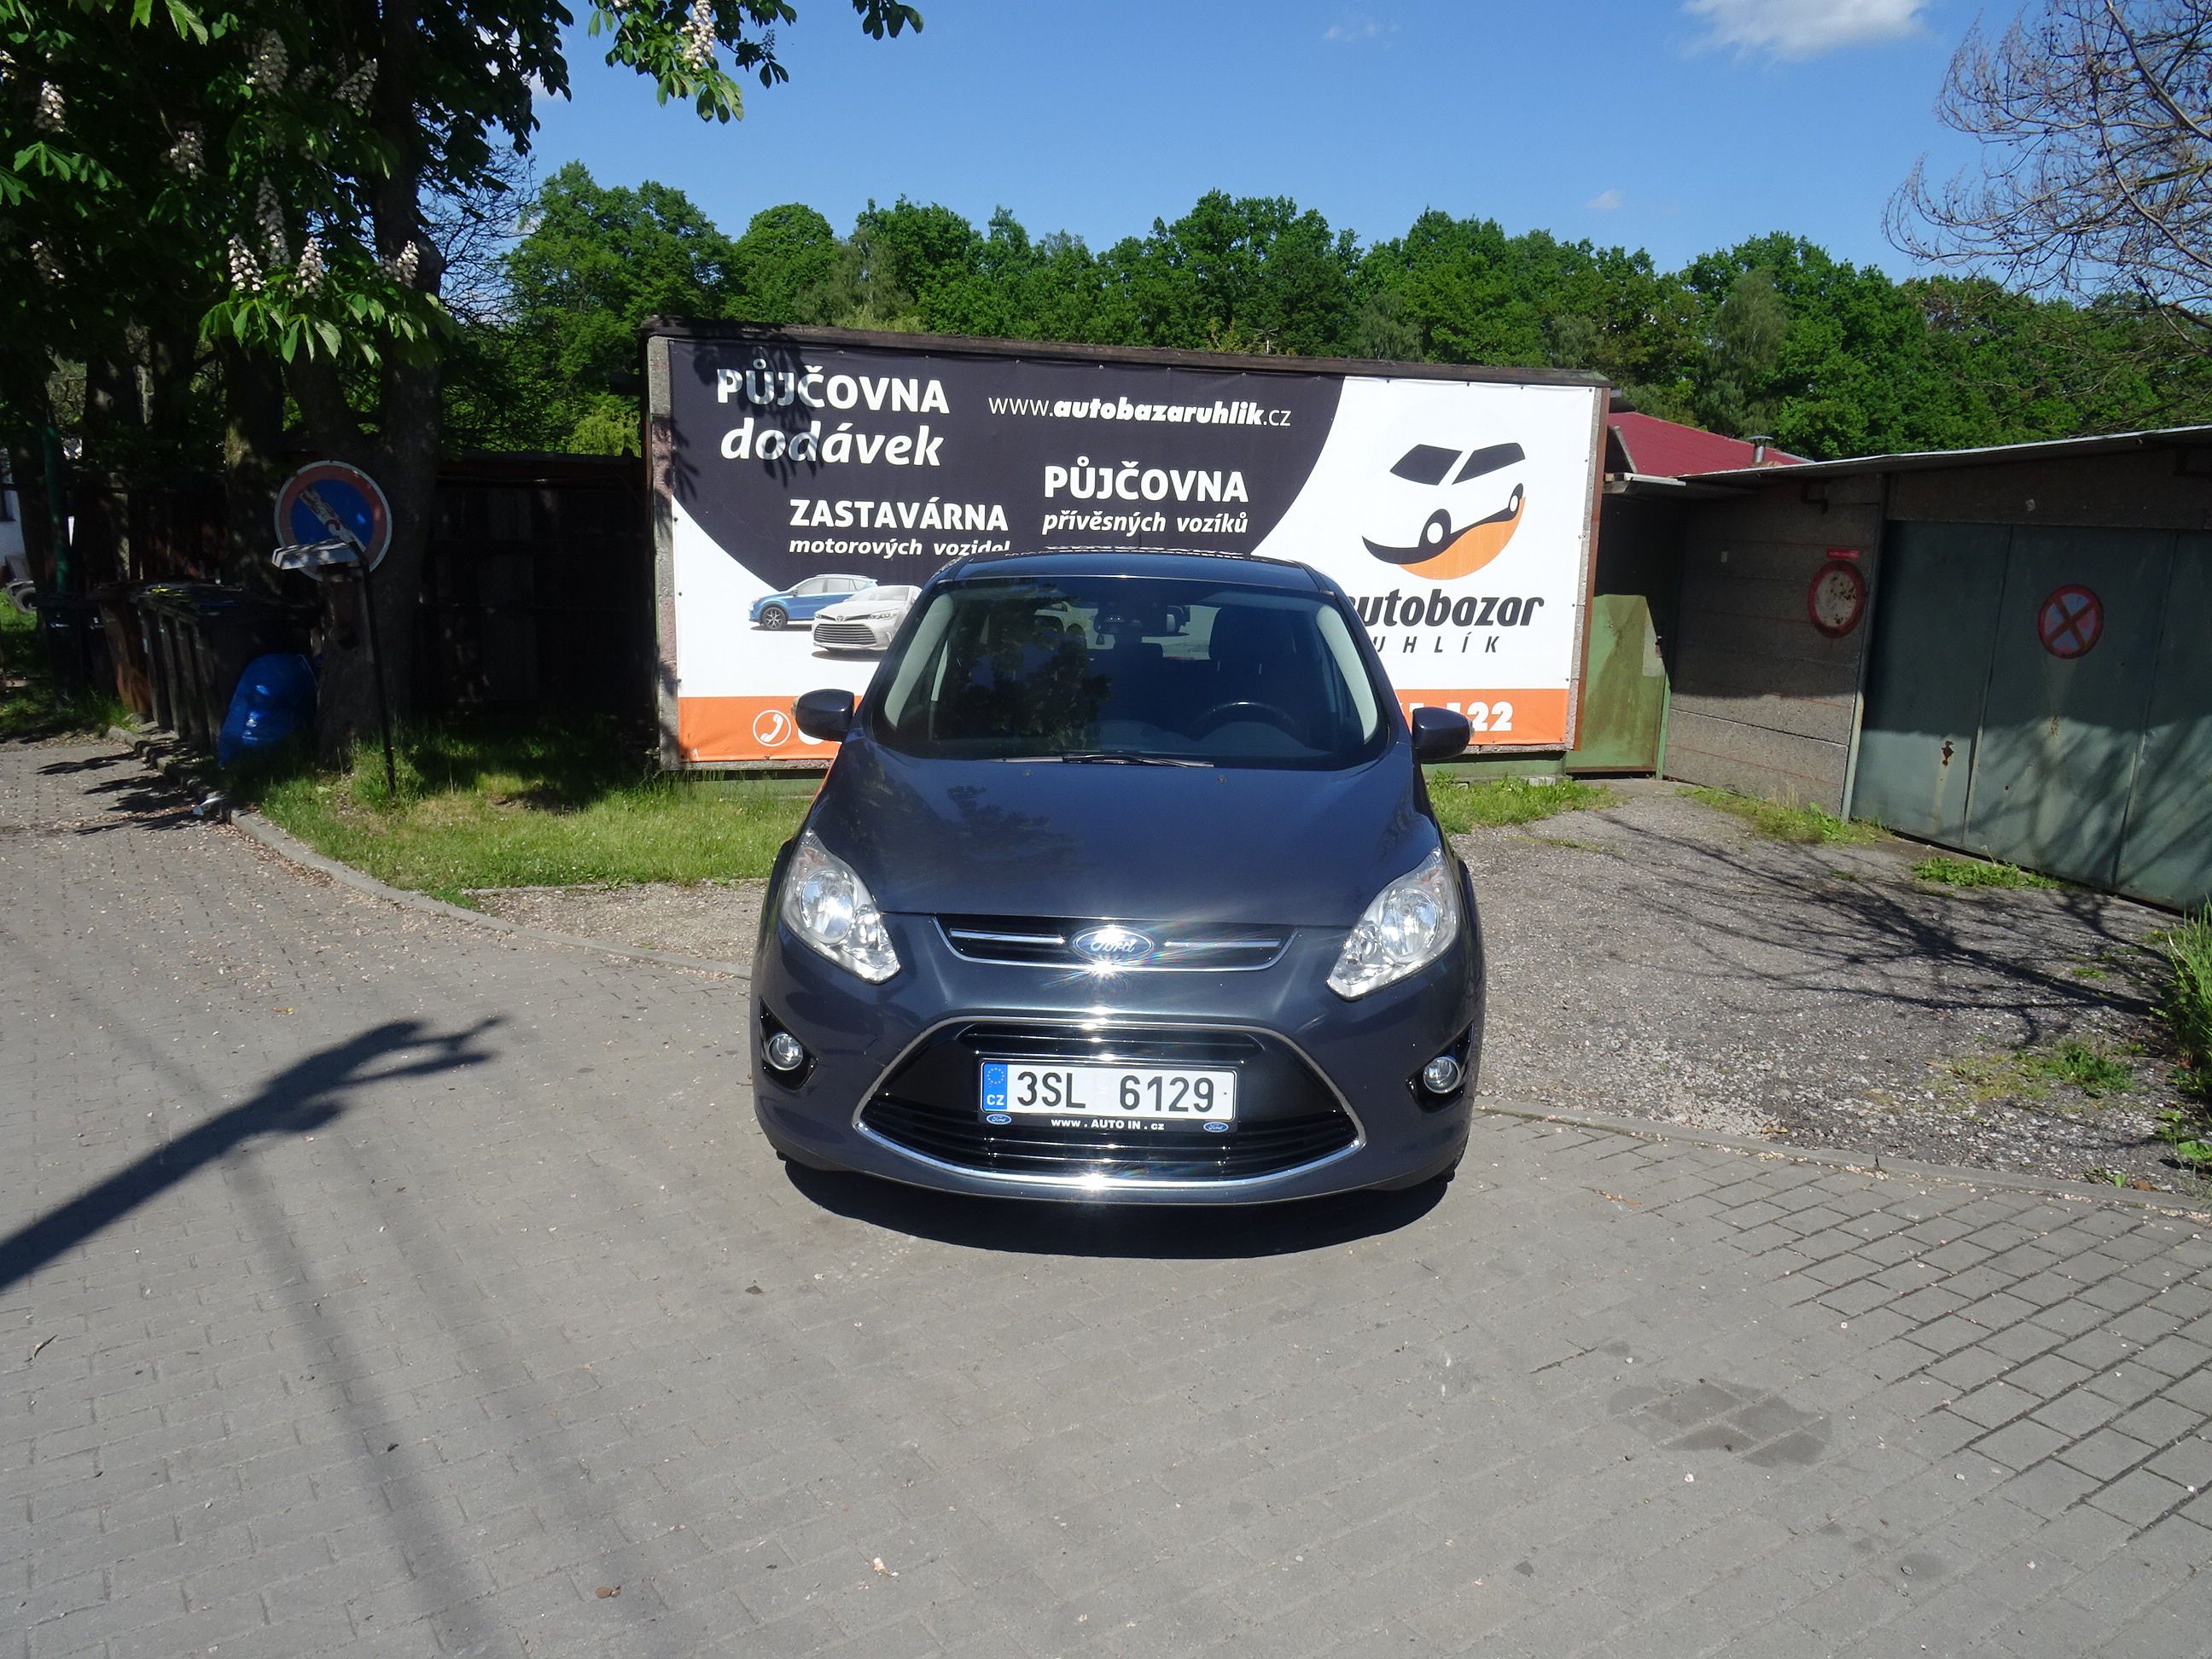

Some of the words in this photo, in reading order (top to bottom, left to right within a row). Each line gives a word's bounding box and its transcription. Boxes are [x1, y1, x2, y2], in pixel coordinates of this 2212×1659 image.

[716, 358, 950, 414] PŮJČOVNA
[988, 396, 1292, 427] www.autobazaruhlik.cz
[720, 417, 945, 467] dodávek
[1044, 456, 1249, 503] PŮJČOVNA
[789, 497, 1009, 531] ZASTAVÁRNA
[1041, 509, 1167, 537] přívěsných
[1177, 512, 1249, 533] vozíků
[789, 538, 923, 559] motorových
[1348, 588, 1545, 627] utobazar
[1446, 701, 1513, 731] 22
[987, 1094, 1004, 1106] CZ
[1017, 1071, 1086, 1109] 3SL
[1120, 1075, 1214, 1113] 6129
[1091, 1120, 1125, 1130] AUTO
